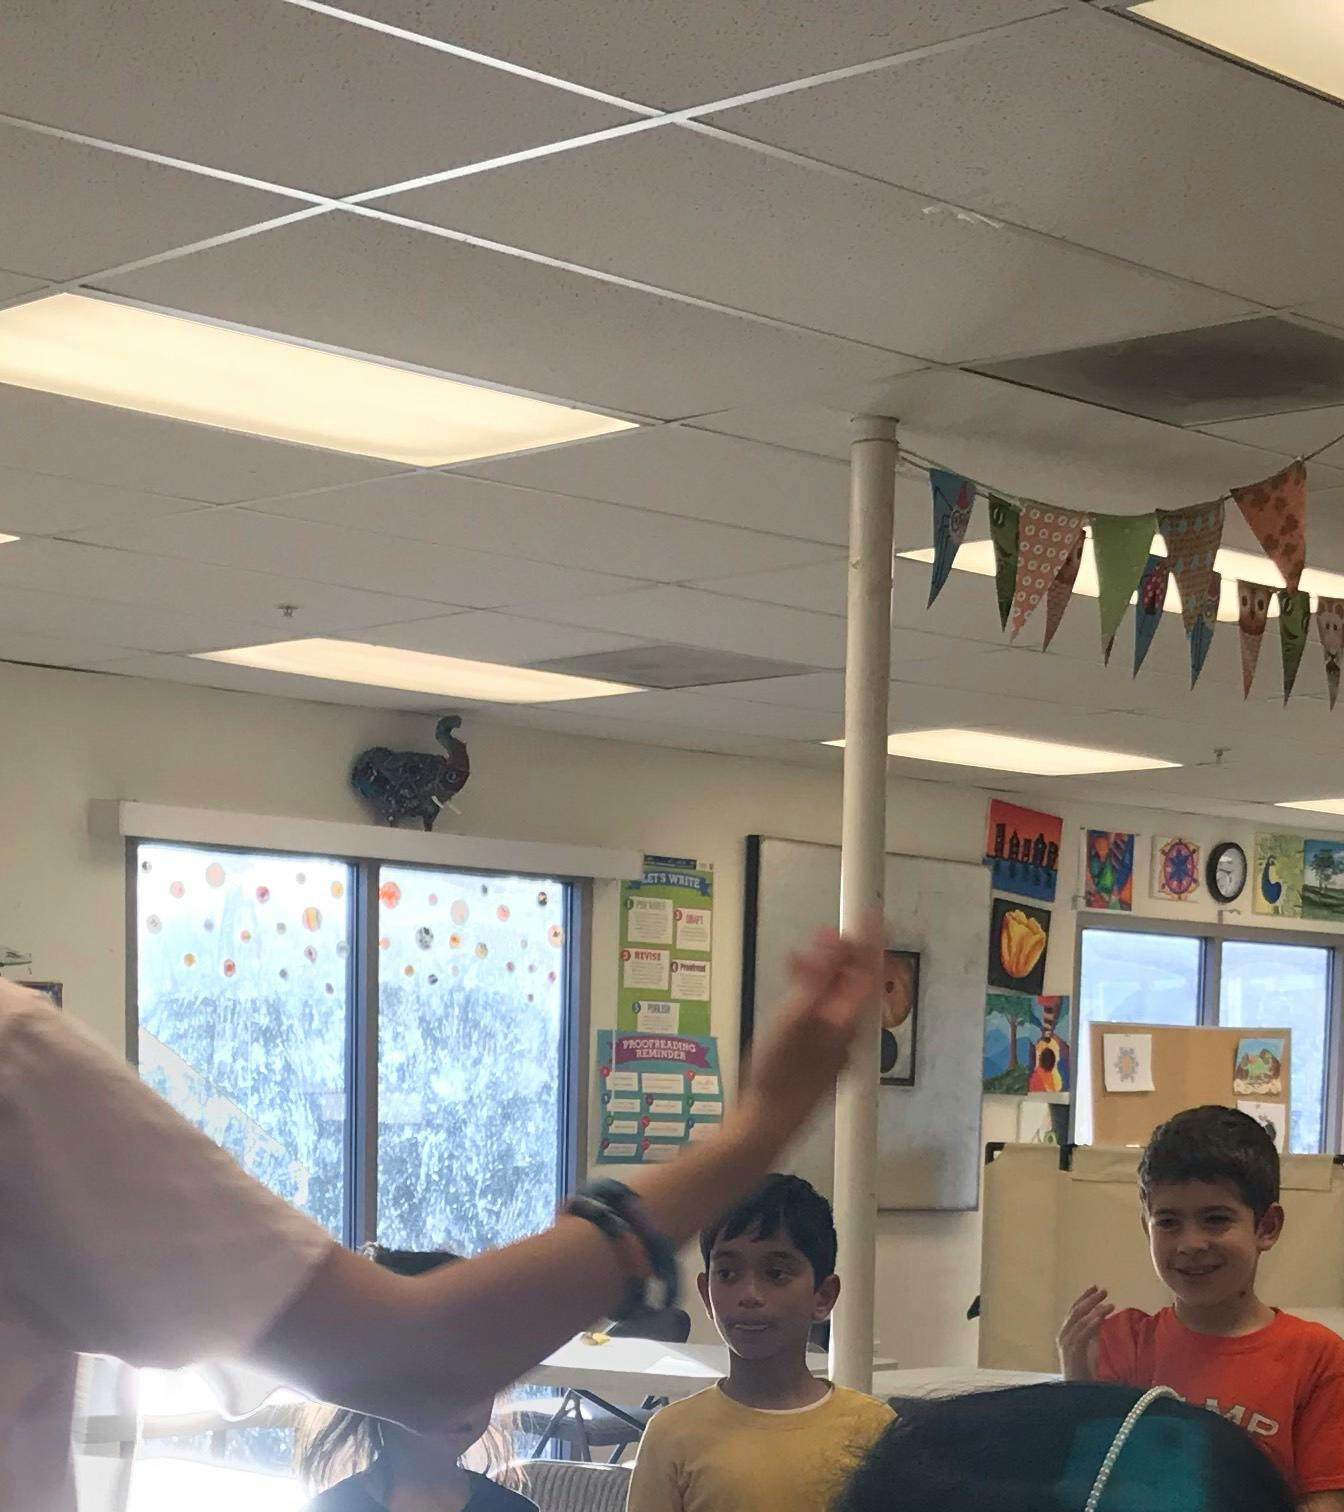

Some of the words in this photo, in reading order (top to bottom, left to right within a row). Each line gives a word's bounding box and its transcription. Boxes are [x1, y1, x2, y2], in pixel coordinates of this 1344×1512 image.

[640, 872, 666, 884] LET'S
[668, 873, 701, 889] WRITE
[634, 951, 661, 960] REVISE
[623, 1040, 696, 1053] PROOFREADING
[636, 1048, 686, 1060] REMINDER
